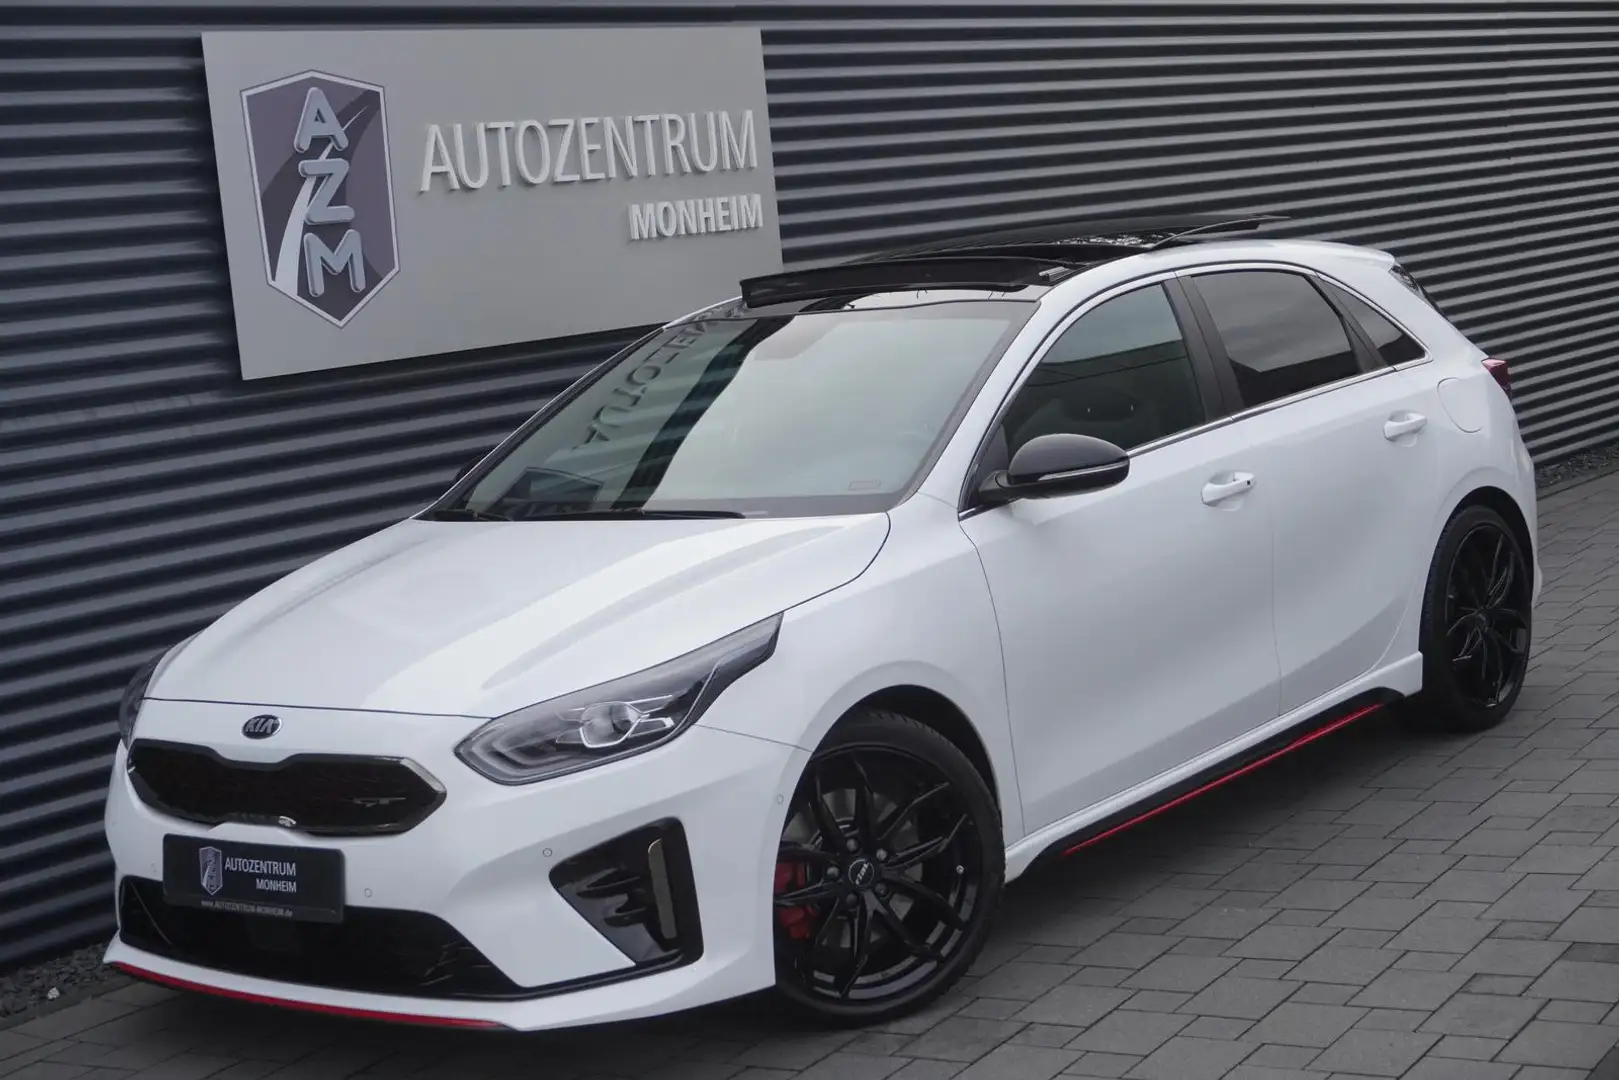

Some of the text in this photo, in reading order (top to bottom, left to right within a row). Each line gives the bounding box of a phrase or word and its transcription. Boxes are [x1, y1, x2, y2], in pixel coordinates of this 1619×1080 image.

[419, 109, 760, 194] AUTOZENTRUM
[294, 85, 367, 298] AZM
[628, 194, 764, 241] MONHEIM
[244, 717, 275, 734] KIA
[224, 856, 297, 876] AUTOZENTRUM
[255, 878, 297, 893] MONHEIM
